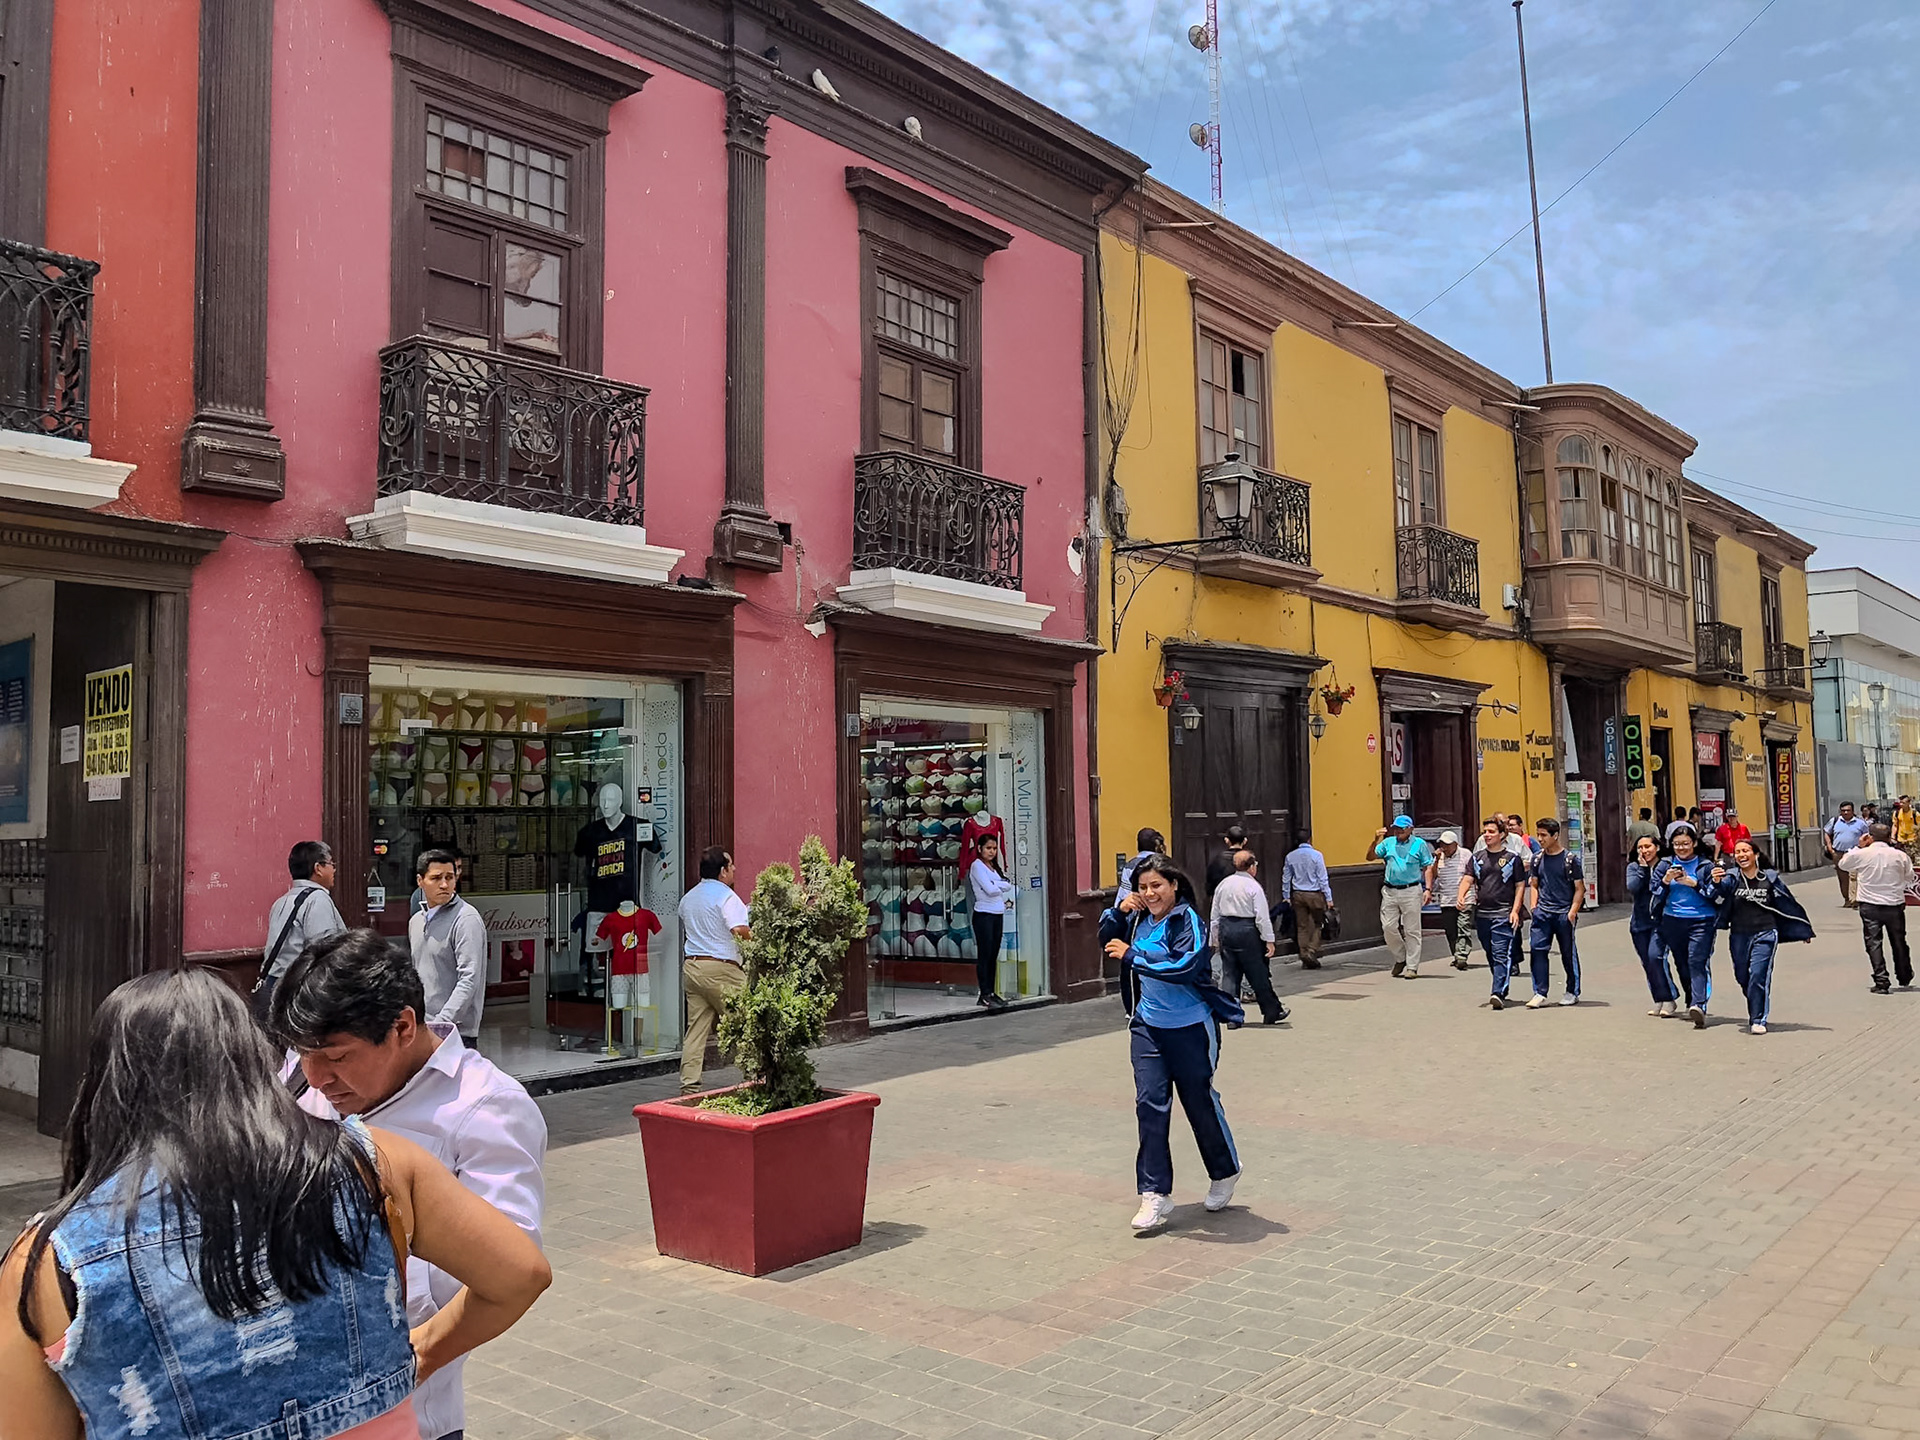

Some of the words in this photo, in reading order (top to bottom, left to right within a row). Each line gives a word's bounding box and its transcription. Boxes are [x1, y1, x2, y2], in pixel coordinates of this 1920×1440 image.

[88, 671, 130, 717] VENDO
[1605, 717, 1616, 769] COPIAS
[1624, 725, 1643, 780] ORO
[653, 732, 668, 842] Multimoda
[1779, 753, 1791, 804] EUROS
